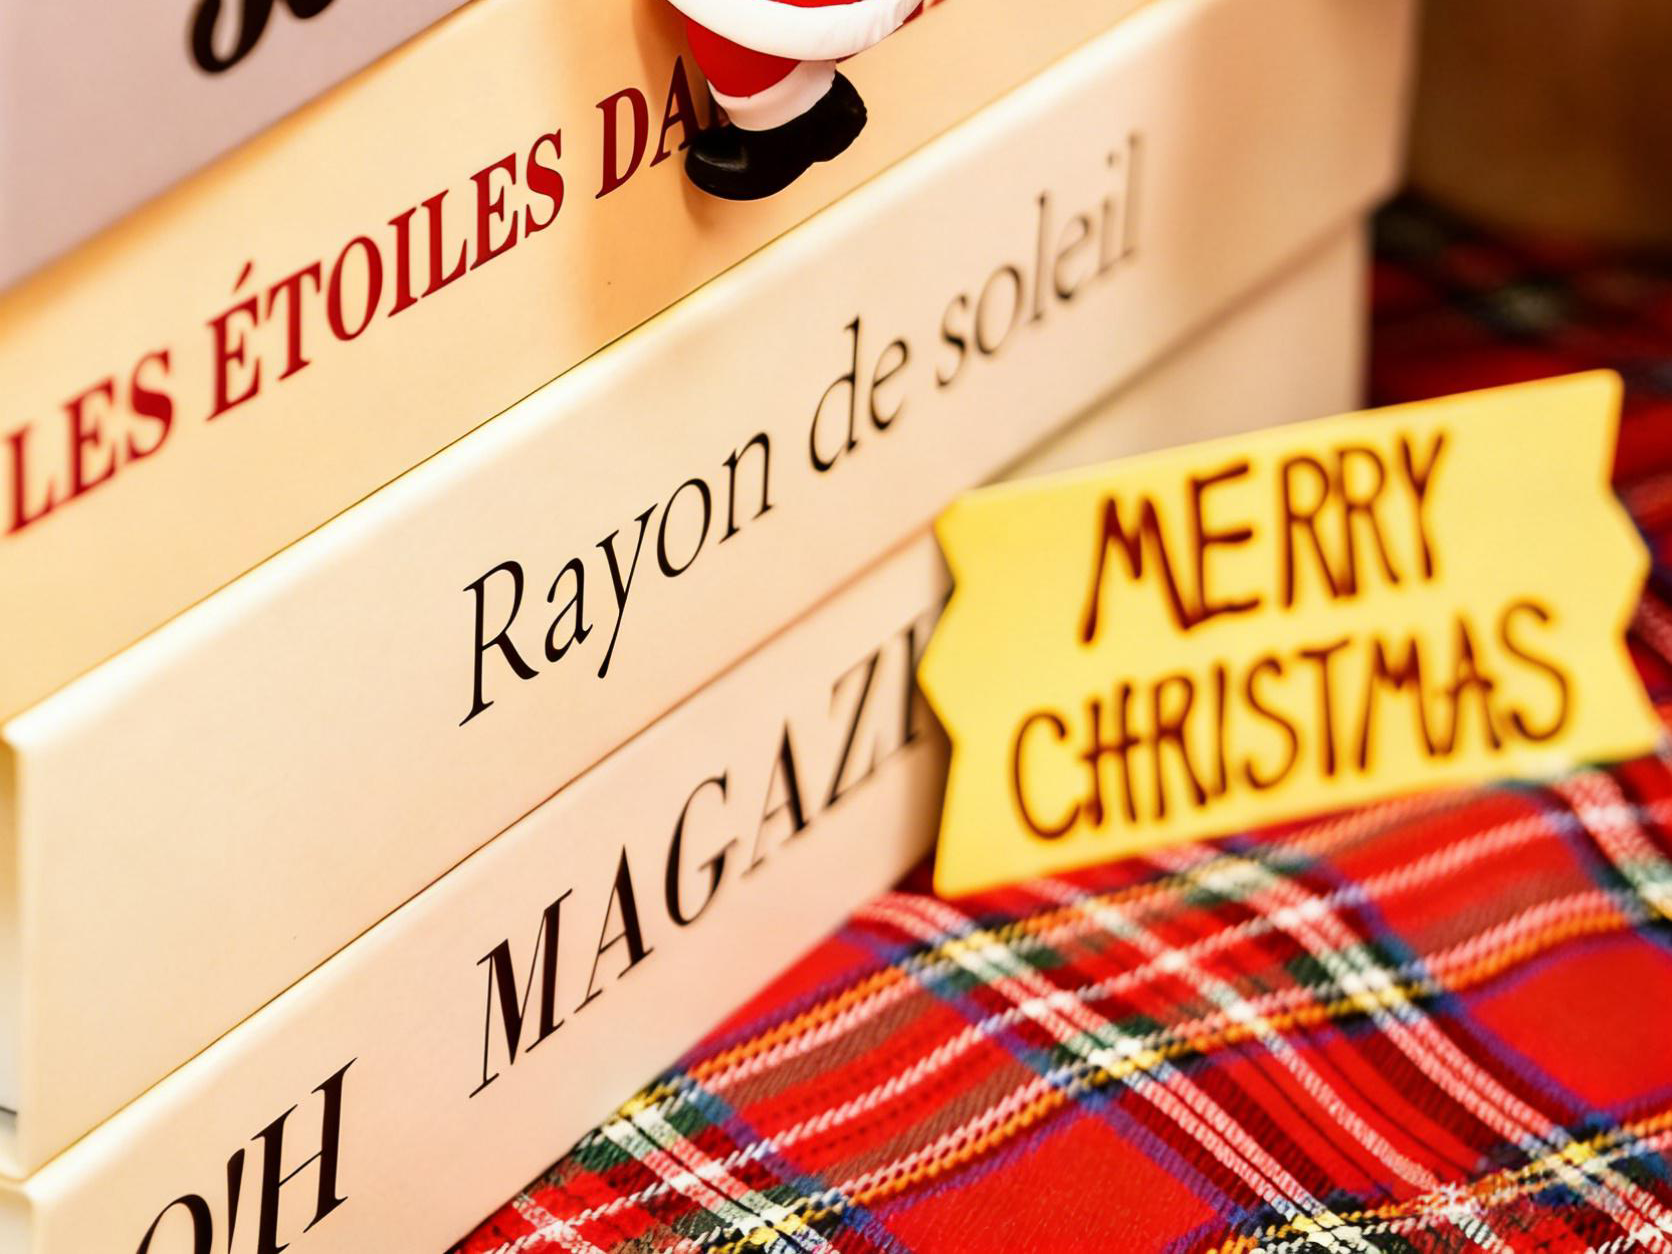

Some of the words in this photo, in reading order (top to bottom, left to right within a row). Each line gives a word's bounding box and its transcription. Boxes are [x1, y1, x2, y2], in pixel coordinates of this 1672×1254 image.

[4, 348, 174, 536] LES
[205, 128, 565, 422] ÉTOILES
[595, 54, 728, 200] DA
[459, 432, 775, 726] Rayon
[809, 314, 912, 473] de
[934, 129, 1147, 389] soleil
[1077, 431, 1446, 646] MERRY
[1010, 600, 1571, 840] CHRISTMAS
